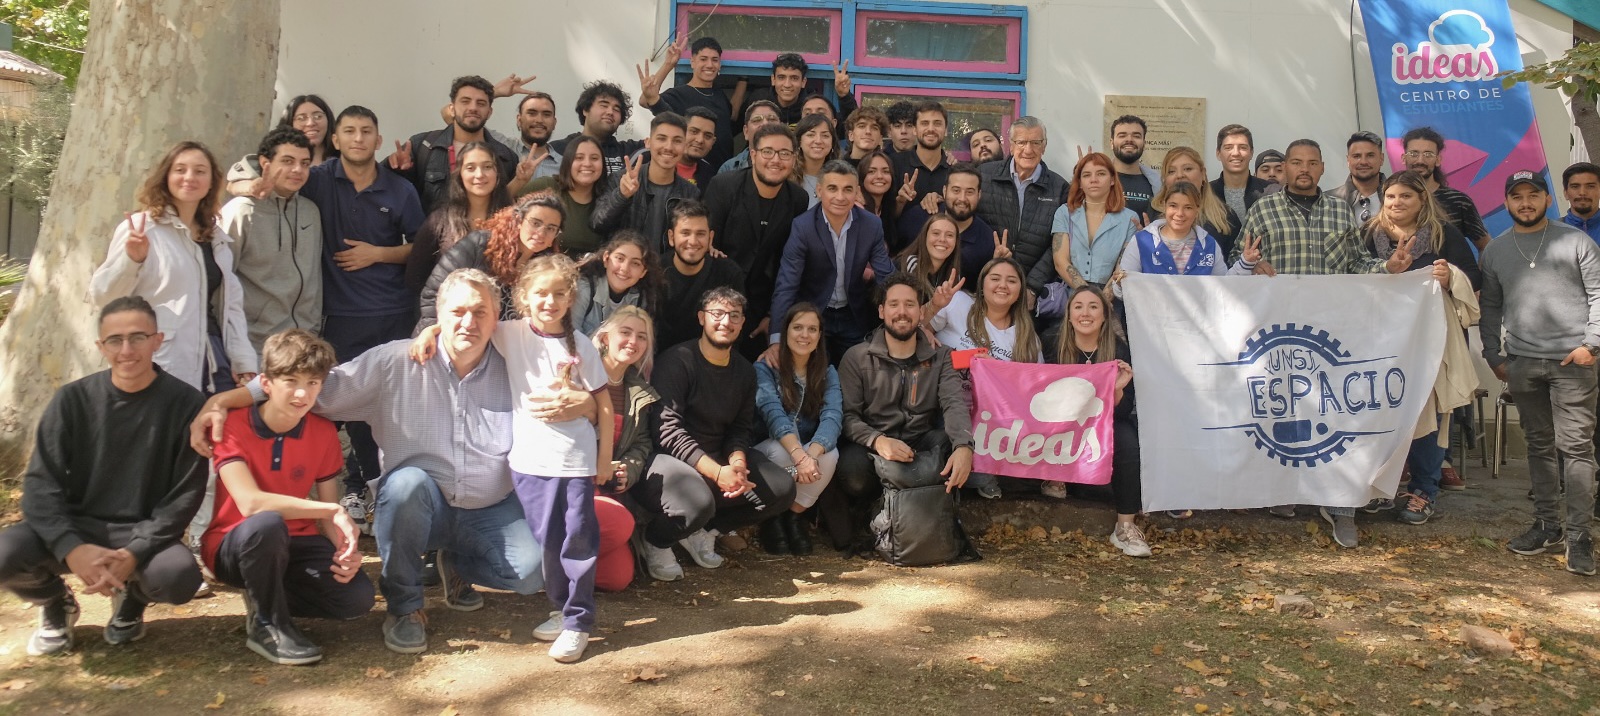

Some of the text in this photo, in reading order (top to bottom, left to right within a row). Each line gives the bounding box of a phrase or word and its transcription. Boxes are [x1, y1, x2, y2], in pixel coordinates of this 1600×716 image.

[1395, 45, 1495, 81] ideas
[1400, 87, 1501, 102] CENTRO DE
[1402, 101, 1504, 115] ESTUDIANTES
[1247, 367, 1406, 419] ESPACIO
[973, 410, 1101, 466] ideas
